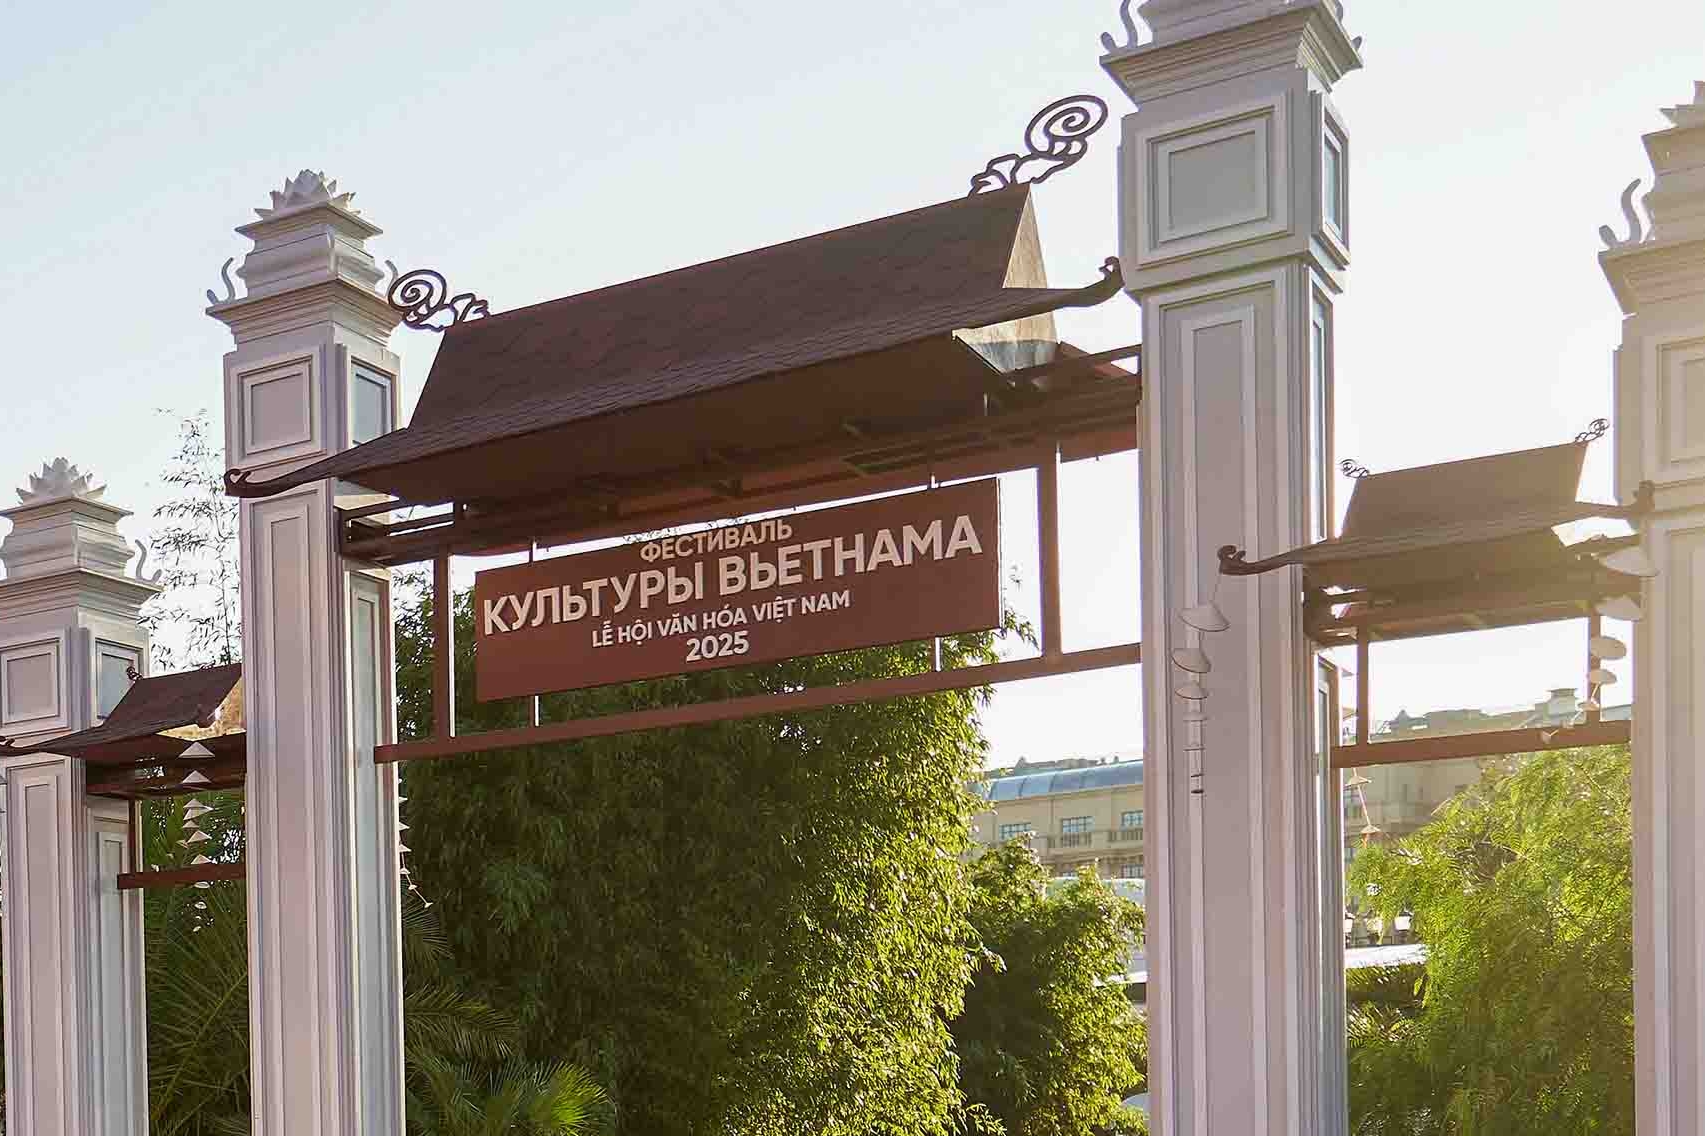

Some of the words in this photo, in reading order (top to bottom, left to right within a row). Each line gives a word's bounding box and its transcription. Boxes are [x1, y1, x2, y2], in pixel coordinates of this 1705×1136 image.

[640, 519, 793, 563] ФЕСТИВАЛЬ
[483, 562, 704, 635] КУЛЬТУРЫ
[719, 514, 983, 597] ВЬЕТНАМА
[618, 618, 653, 646] HỘI
[657, 612, 697, 637] VĂN
[702, 603, 748, 630] HÓA
[752, 596, 797, 624] VIỆT
[801, 589, 851, 616] NAM
[685, 630, 750, 662] 2025
